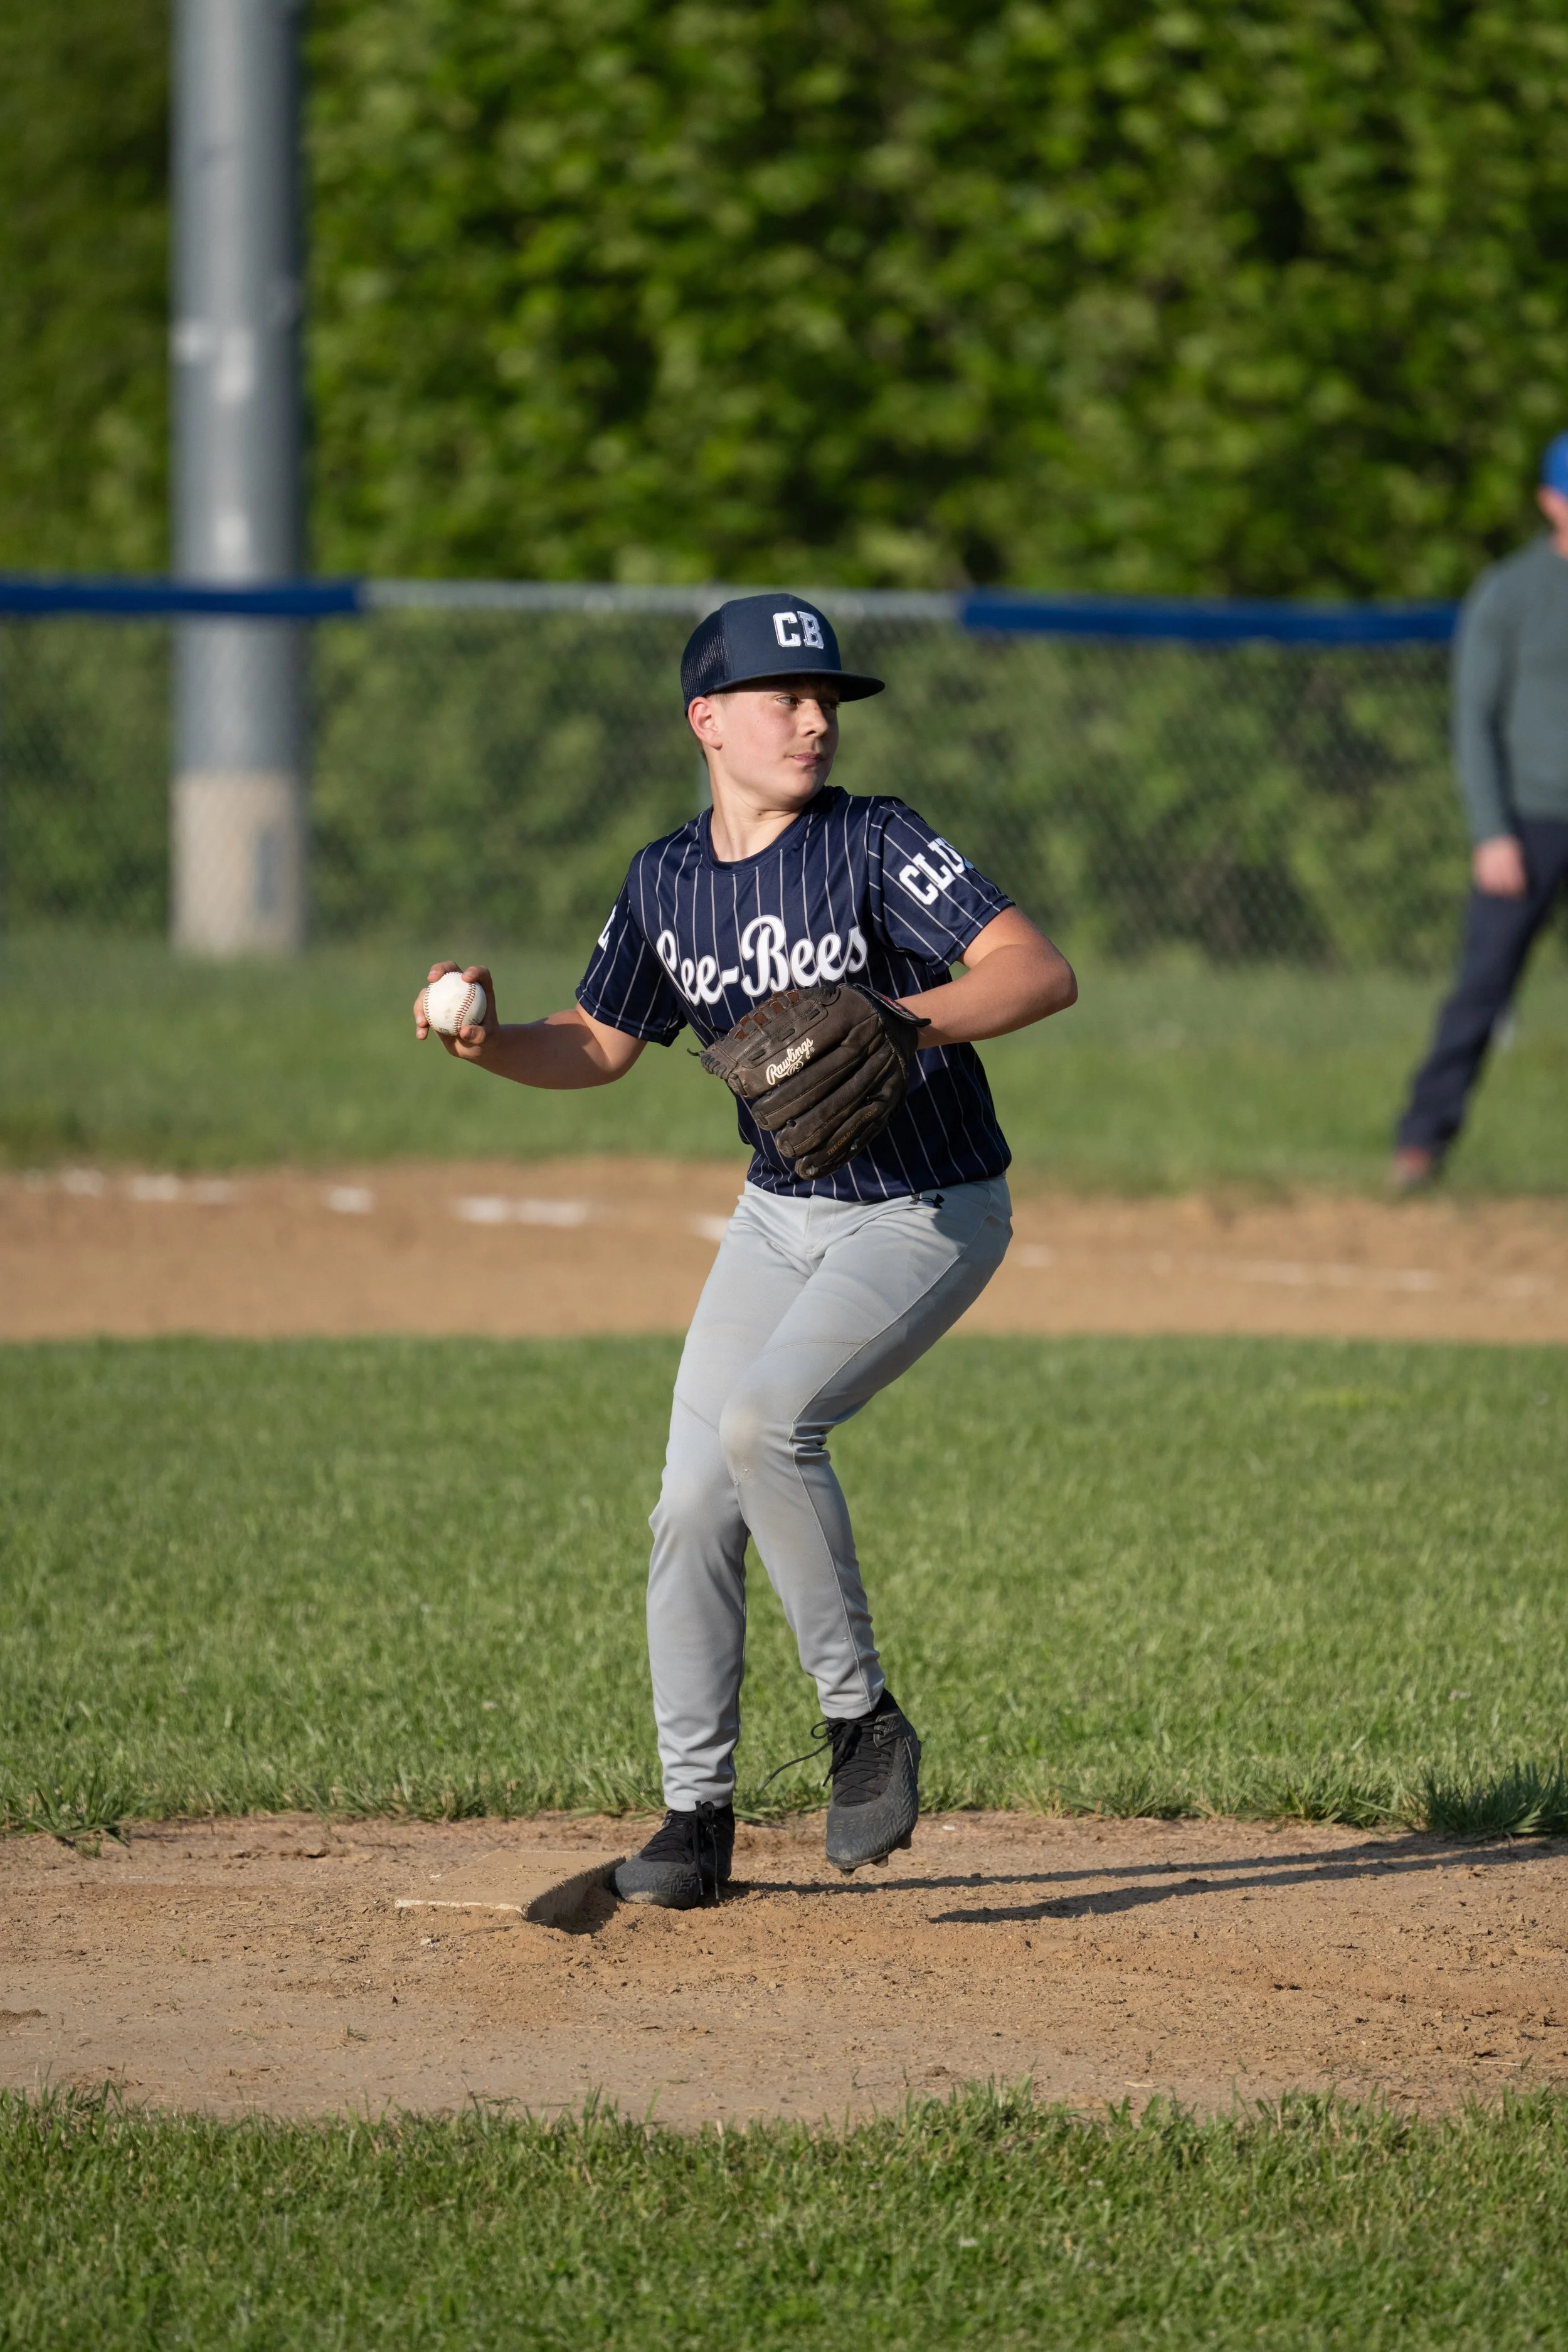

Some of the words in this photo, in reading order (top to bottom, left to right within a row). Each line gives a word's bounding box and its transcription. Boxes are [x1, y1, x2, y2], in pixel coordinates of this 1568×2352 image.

[773, 611, 824, 650] CB
[766, 1037, 813, 1086] Rawlings
[837, 1131, 851, 1146] GOLD
